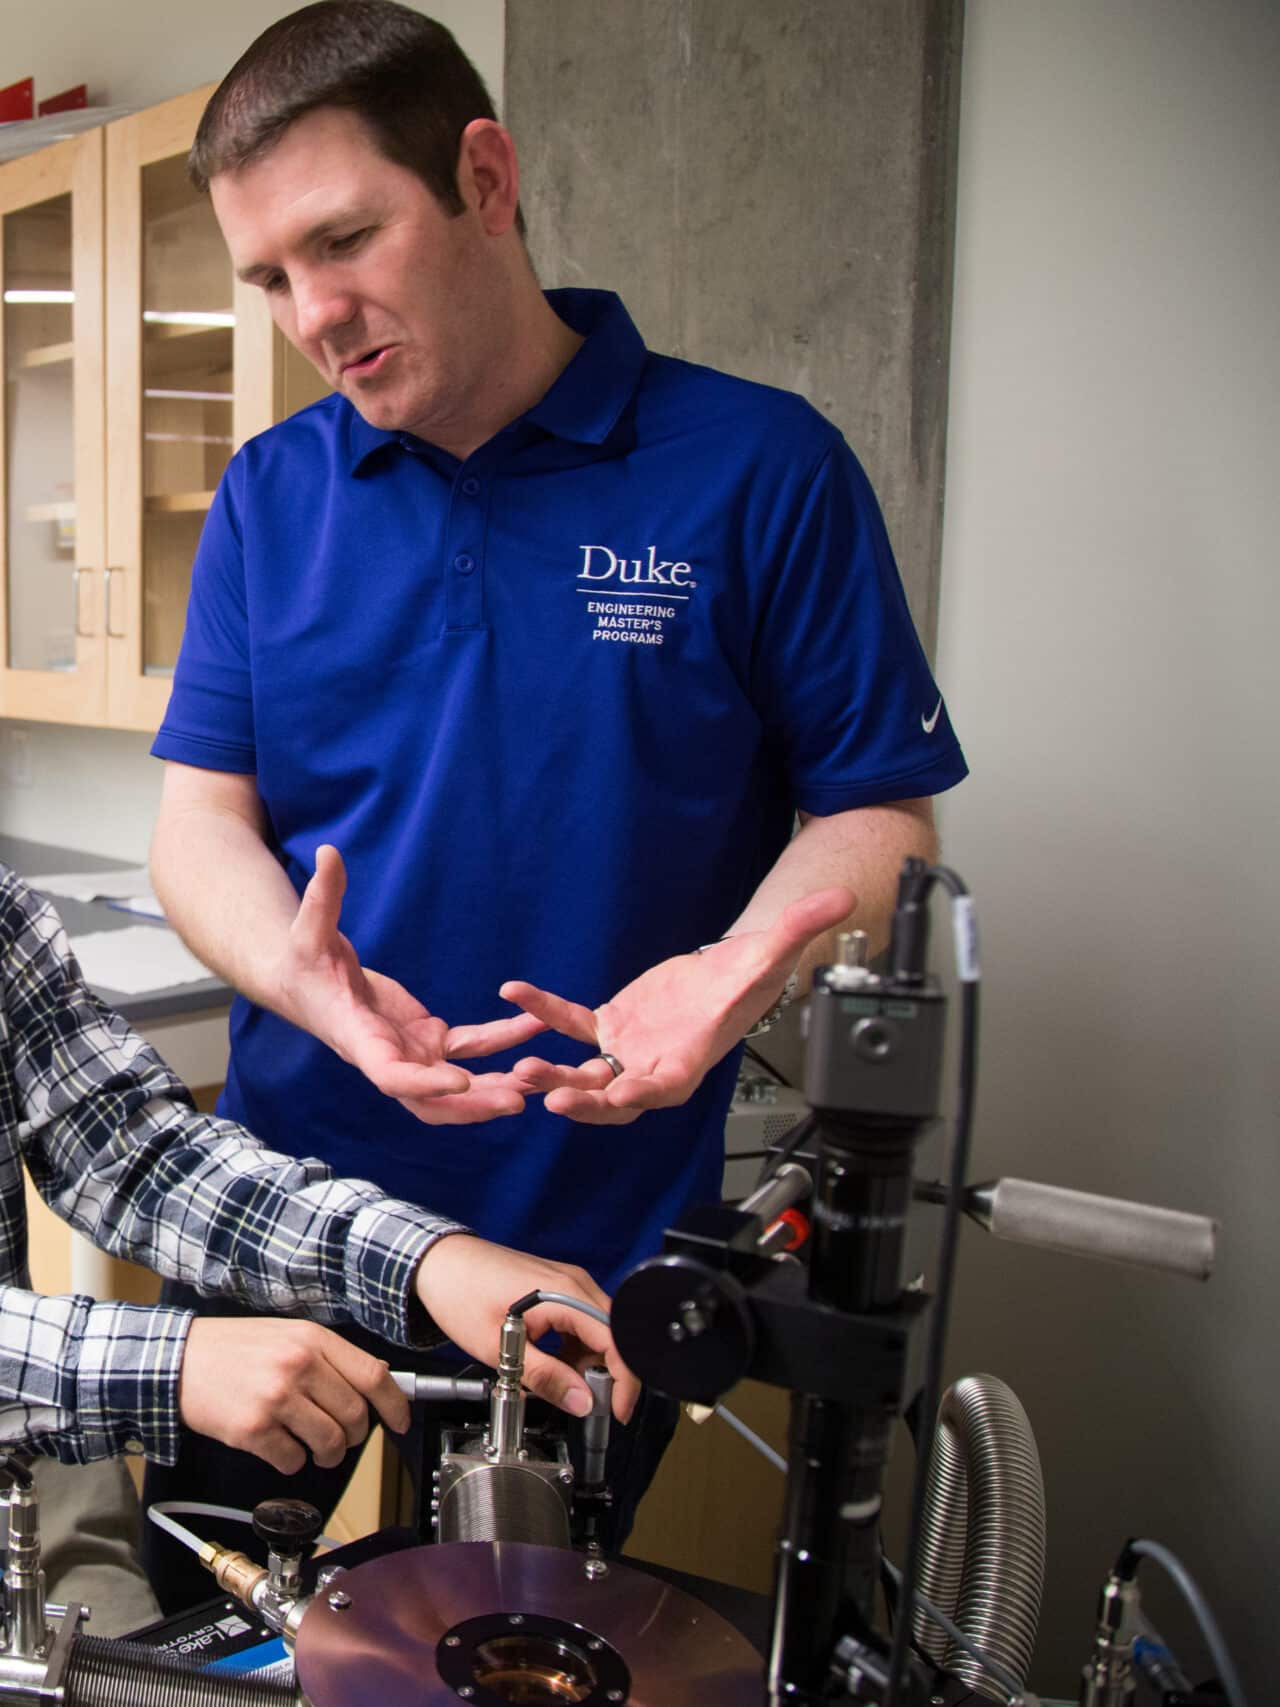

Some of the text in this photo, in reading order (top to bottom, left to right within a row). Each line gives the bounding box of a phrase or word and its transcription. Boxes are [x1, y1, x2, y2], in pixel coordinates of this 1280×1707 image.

[576, 545, 692, 586] Duke
[587, 602, 676, 618] ENGINEERING
[597, 616, 663, 631] MASTER'S
[592, 630, 665, 645] PROGRAMS
[179, 1631, 225, 1654] Lake
